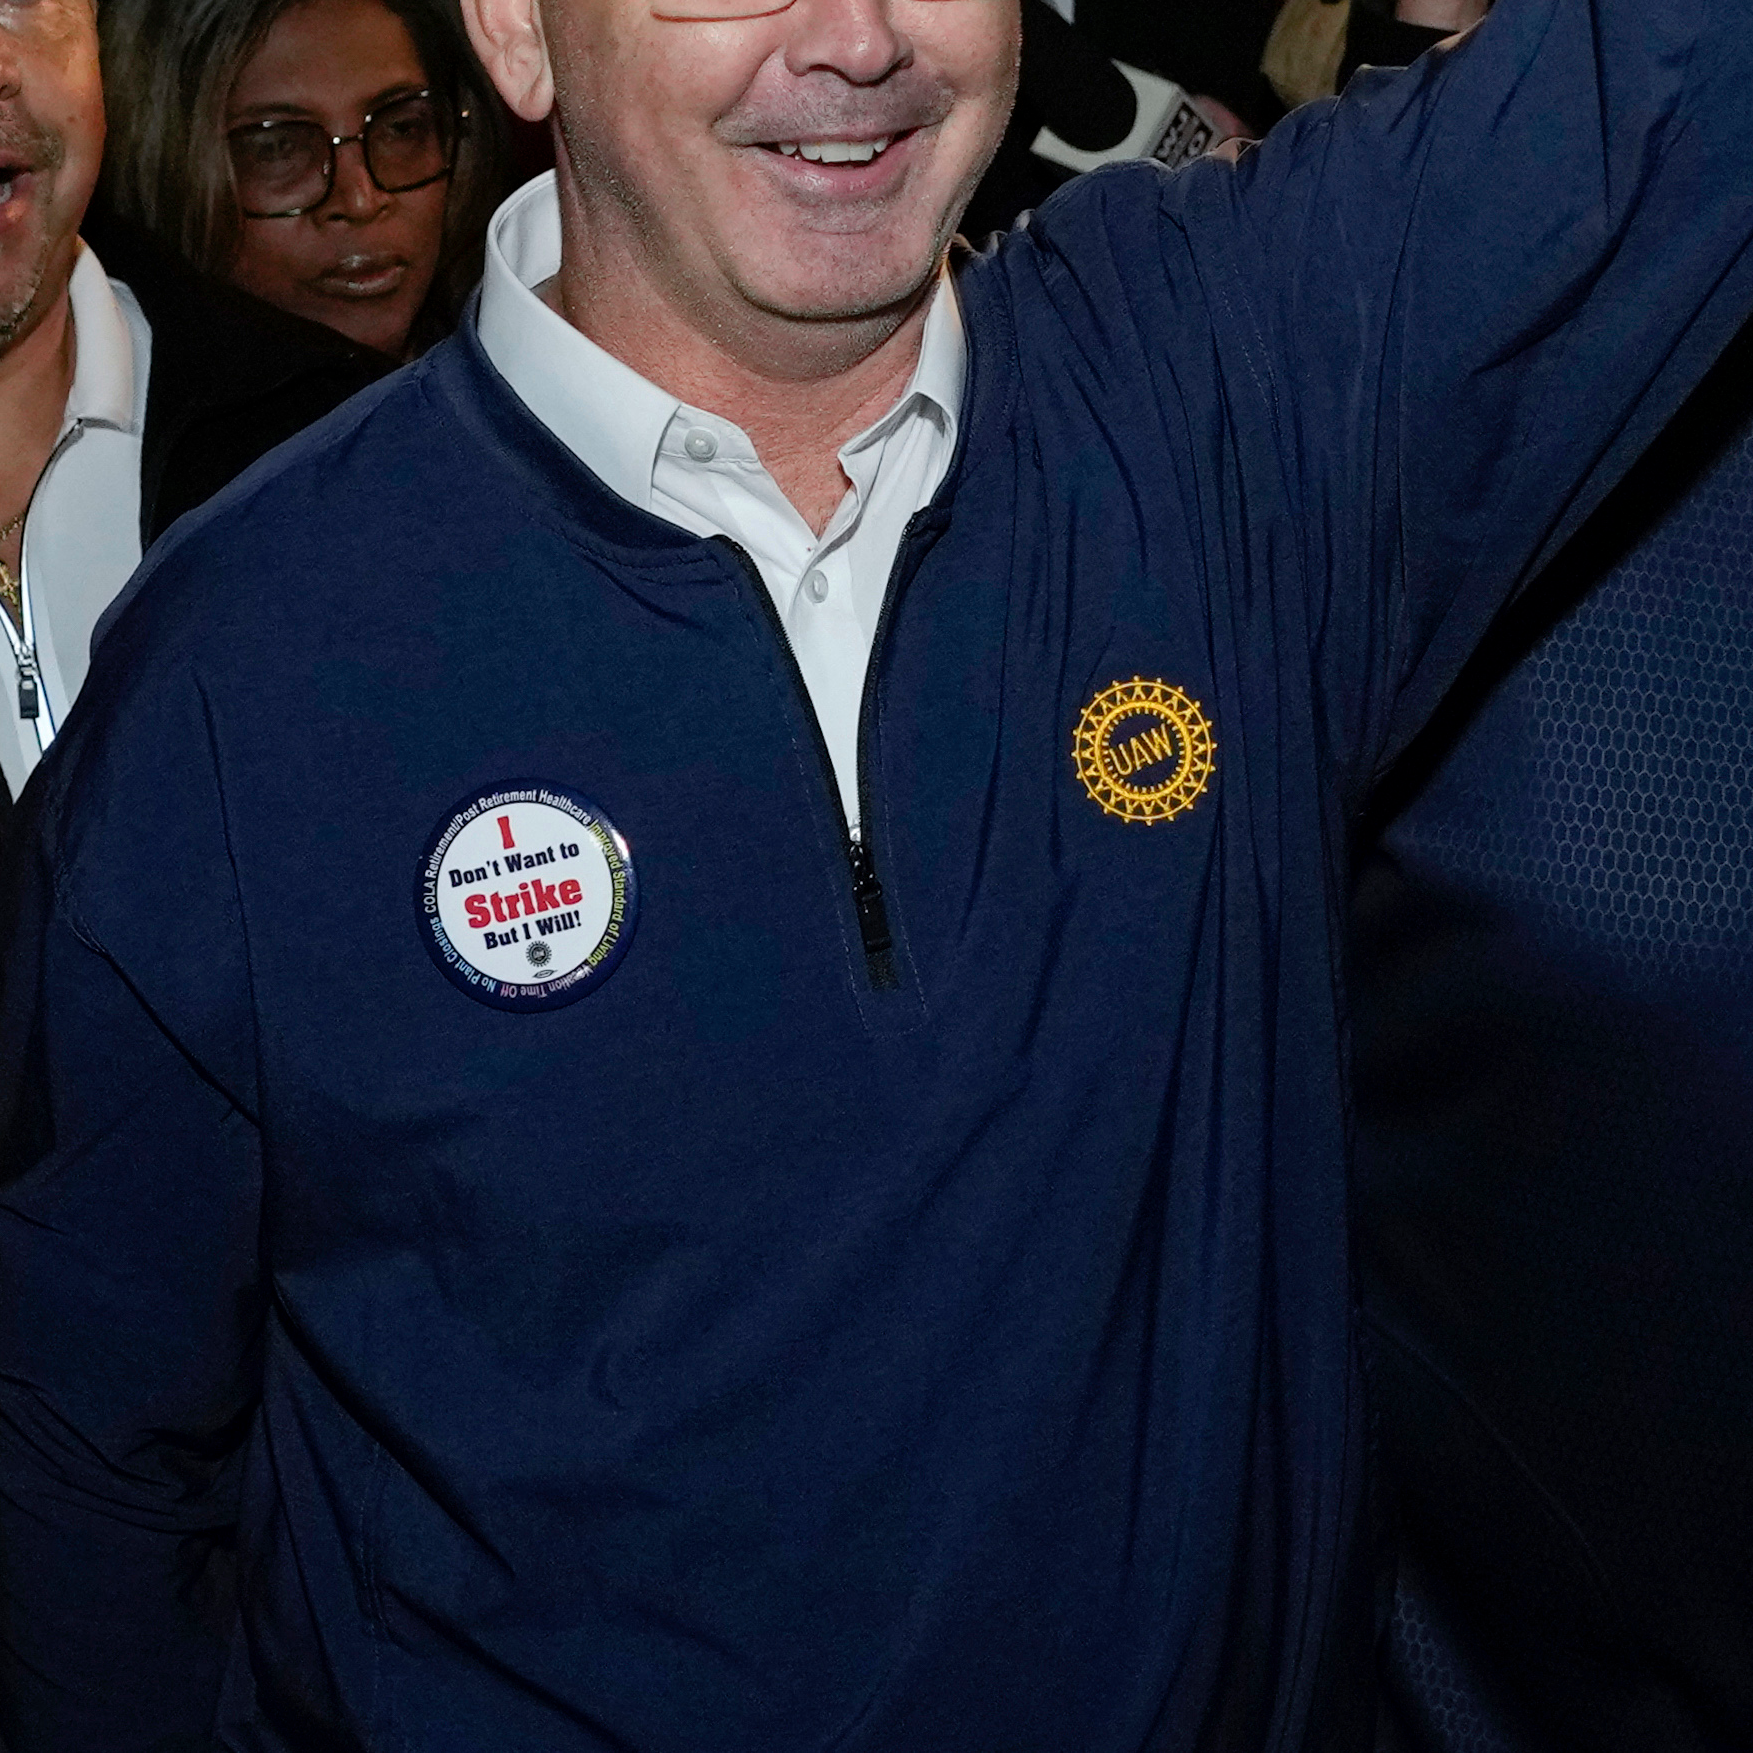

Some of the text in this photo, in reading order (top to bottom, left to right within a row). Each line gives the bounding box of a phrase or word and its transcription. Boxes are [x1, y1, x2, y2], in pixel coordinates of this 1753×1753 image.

[1109, 722, 1173, 776] UAW
[423, 880, 436, 913] COLA
[478, 789, 537, 811] Retirement
[538, 788, 592, 825] Healthcare
[496, 815, 516, 850] I
[448, 842, 580, 888] Don't Want to
[464, 878, 583, 929] Strike
[587, 818, 627, 966] Improved Standard of Living
[483, 909, 582, 950] But I Will!
[429, 917, 497, 993] No Plant Closings
[500, 983, 518, 999] Off
[520, 985, 548, 999] Time
